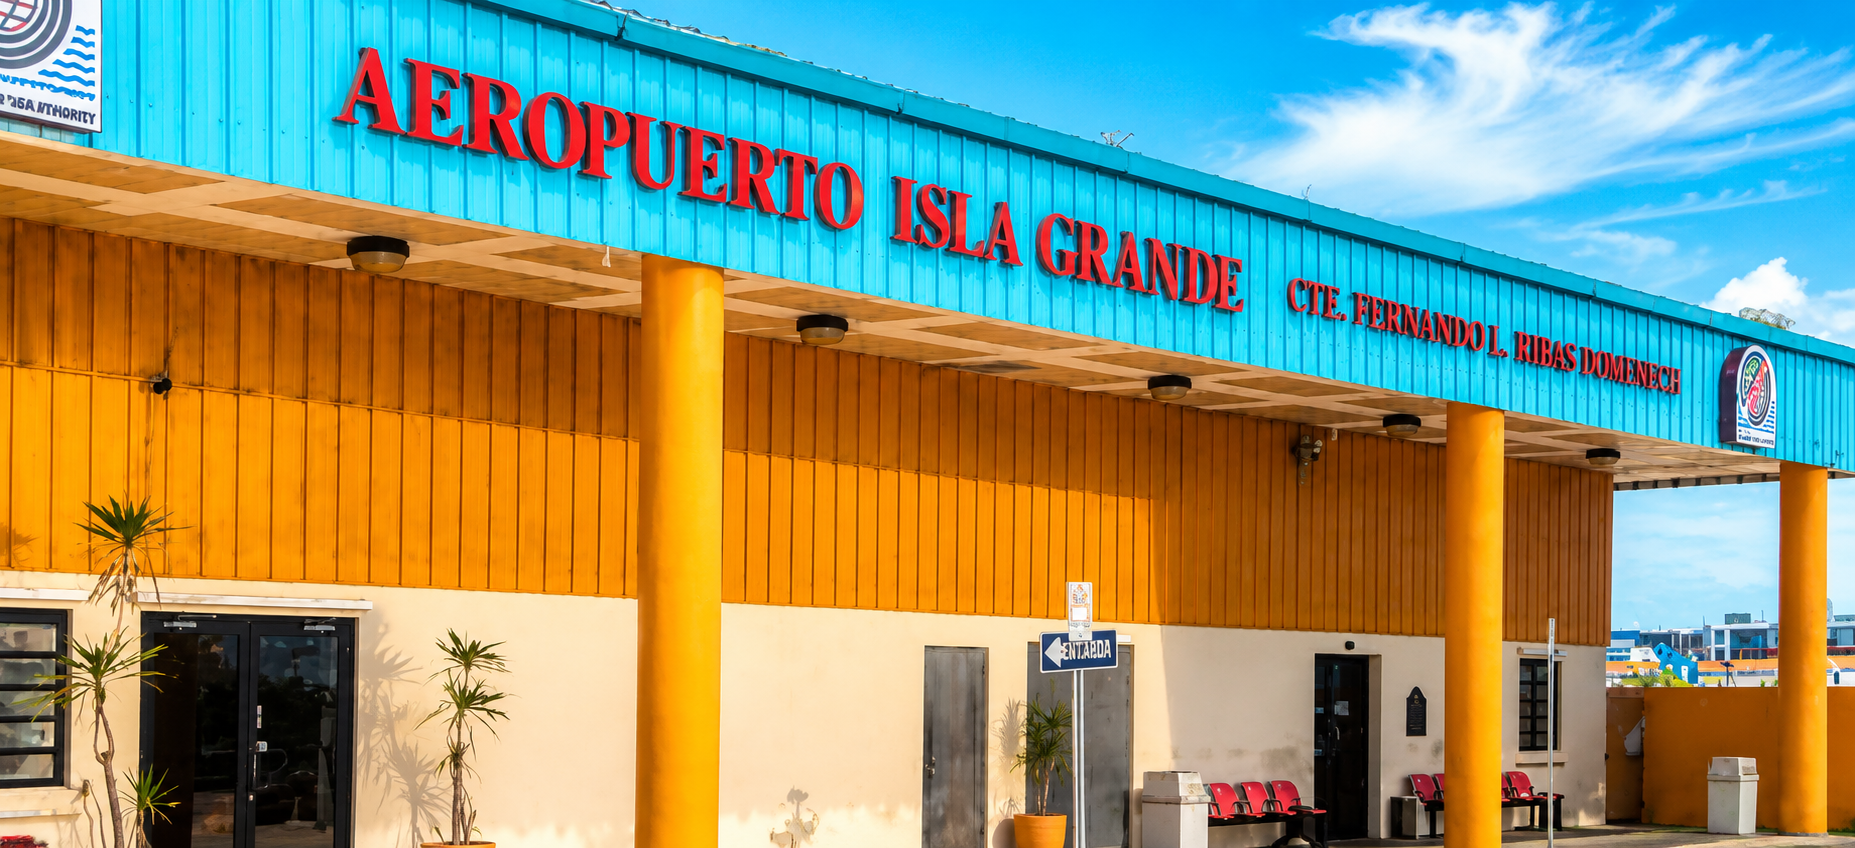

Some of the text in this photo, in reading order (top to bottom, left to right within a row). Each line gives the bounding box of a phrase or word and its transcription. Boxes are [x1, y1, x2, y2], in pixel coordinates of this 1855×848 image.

[332, 46, 1245, 313] AEROPUERTO ISLA GRANDE
[1287, 277, 1682, 396] CTE. FERNANDO L. RIBAS DOMENECH
